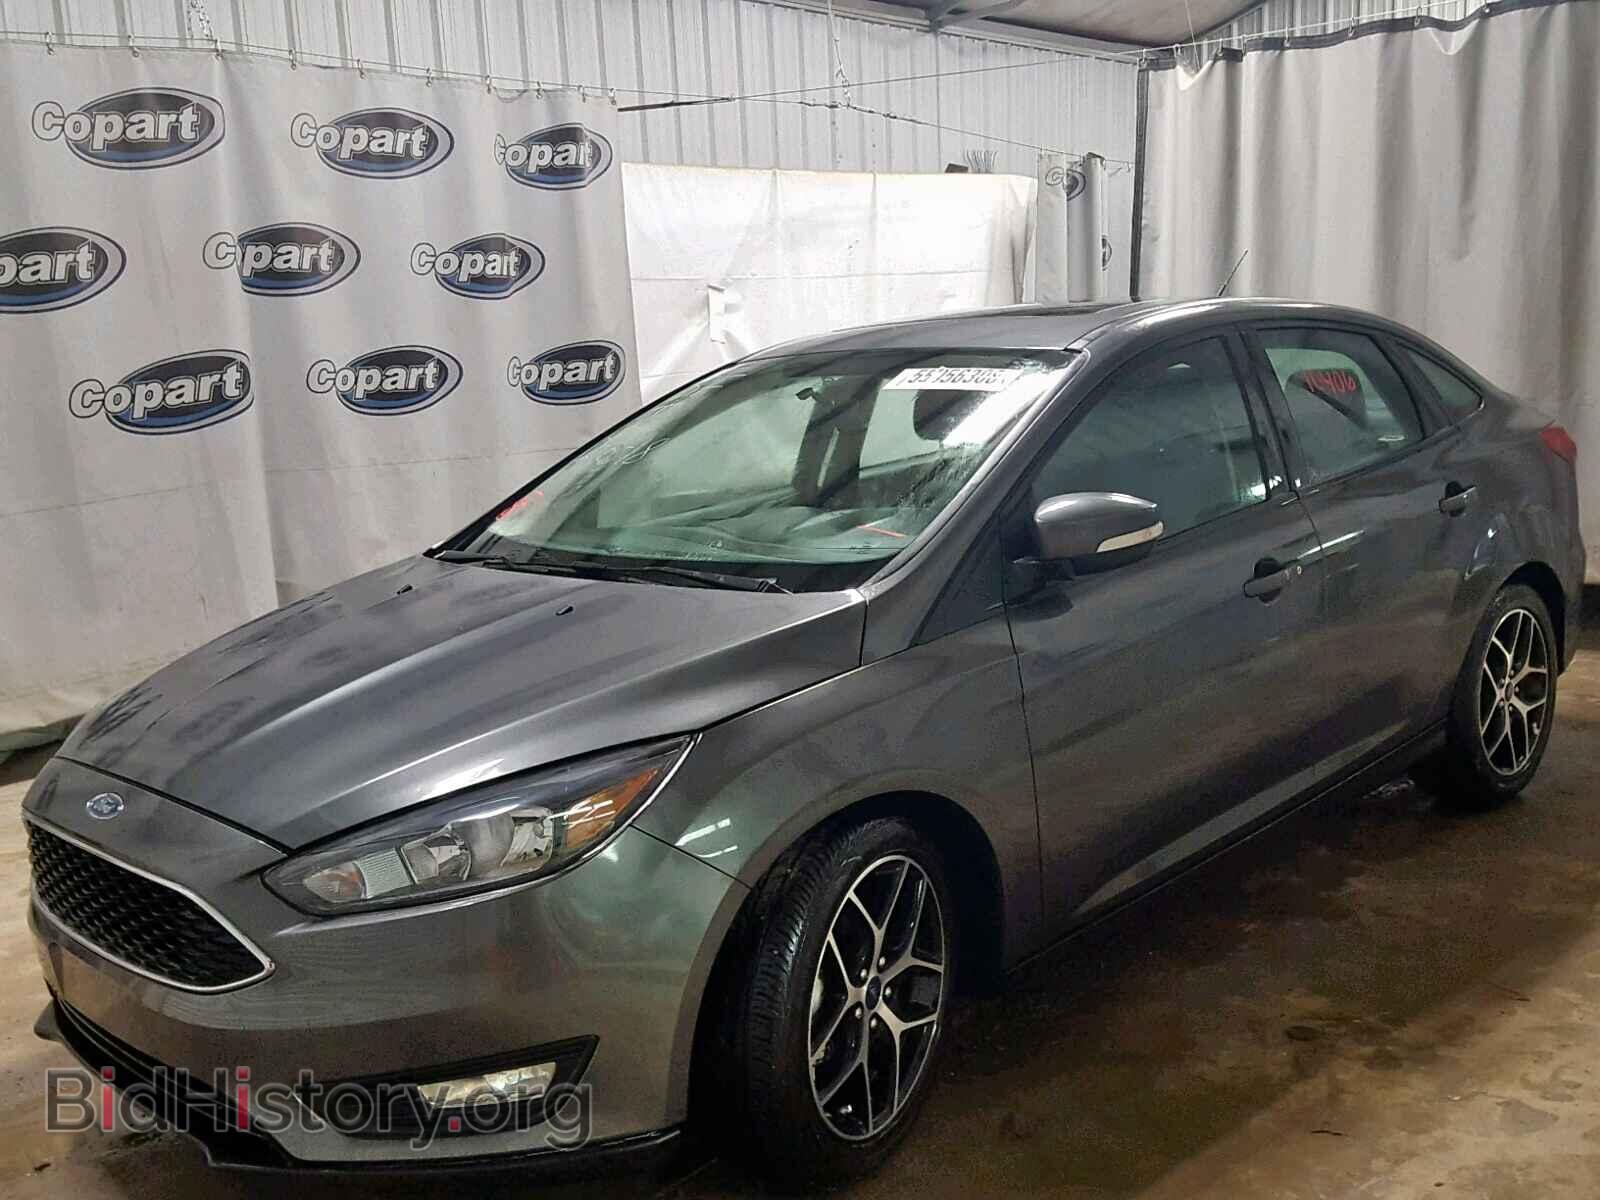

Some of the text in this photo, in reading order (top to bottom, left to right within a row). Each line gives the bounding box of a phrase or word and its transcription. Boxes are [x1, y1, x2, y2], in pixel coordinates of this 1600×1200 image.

[32, 101, 202, 151] Copart
[291, 113, 428, 161] Copart
[203, 231, 335, 279] Cpart
[69, 360, 243, 421] Copart
[307, 357, 440, 400] Copart
[507, 350, 616, 392] Copart
